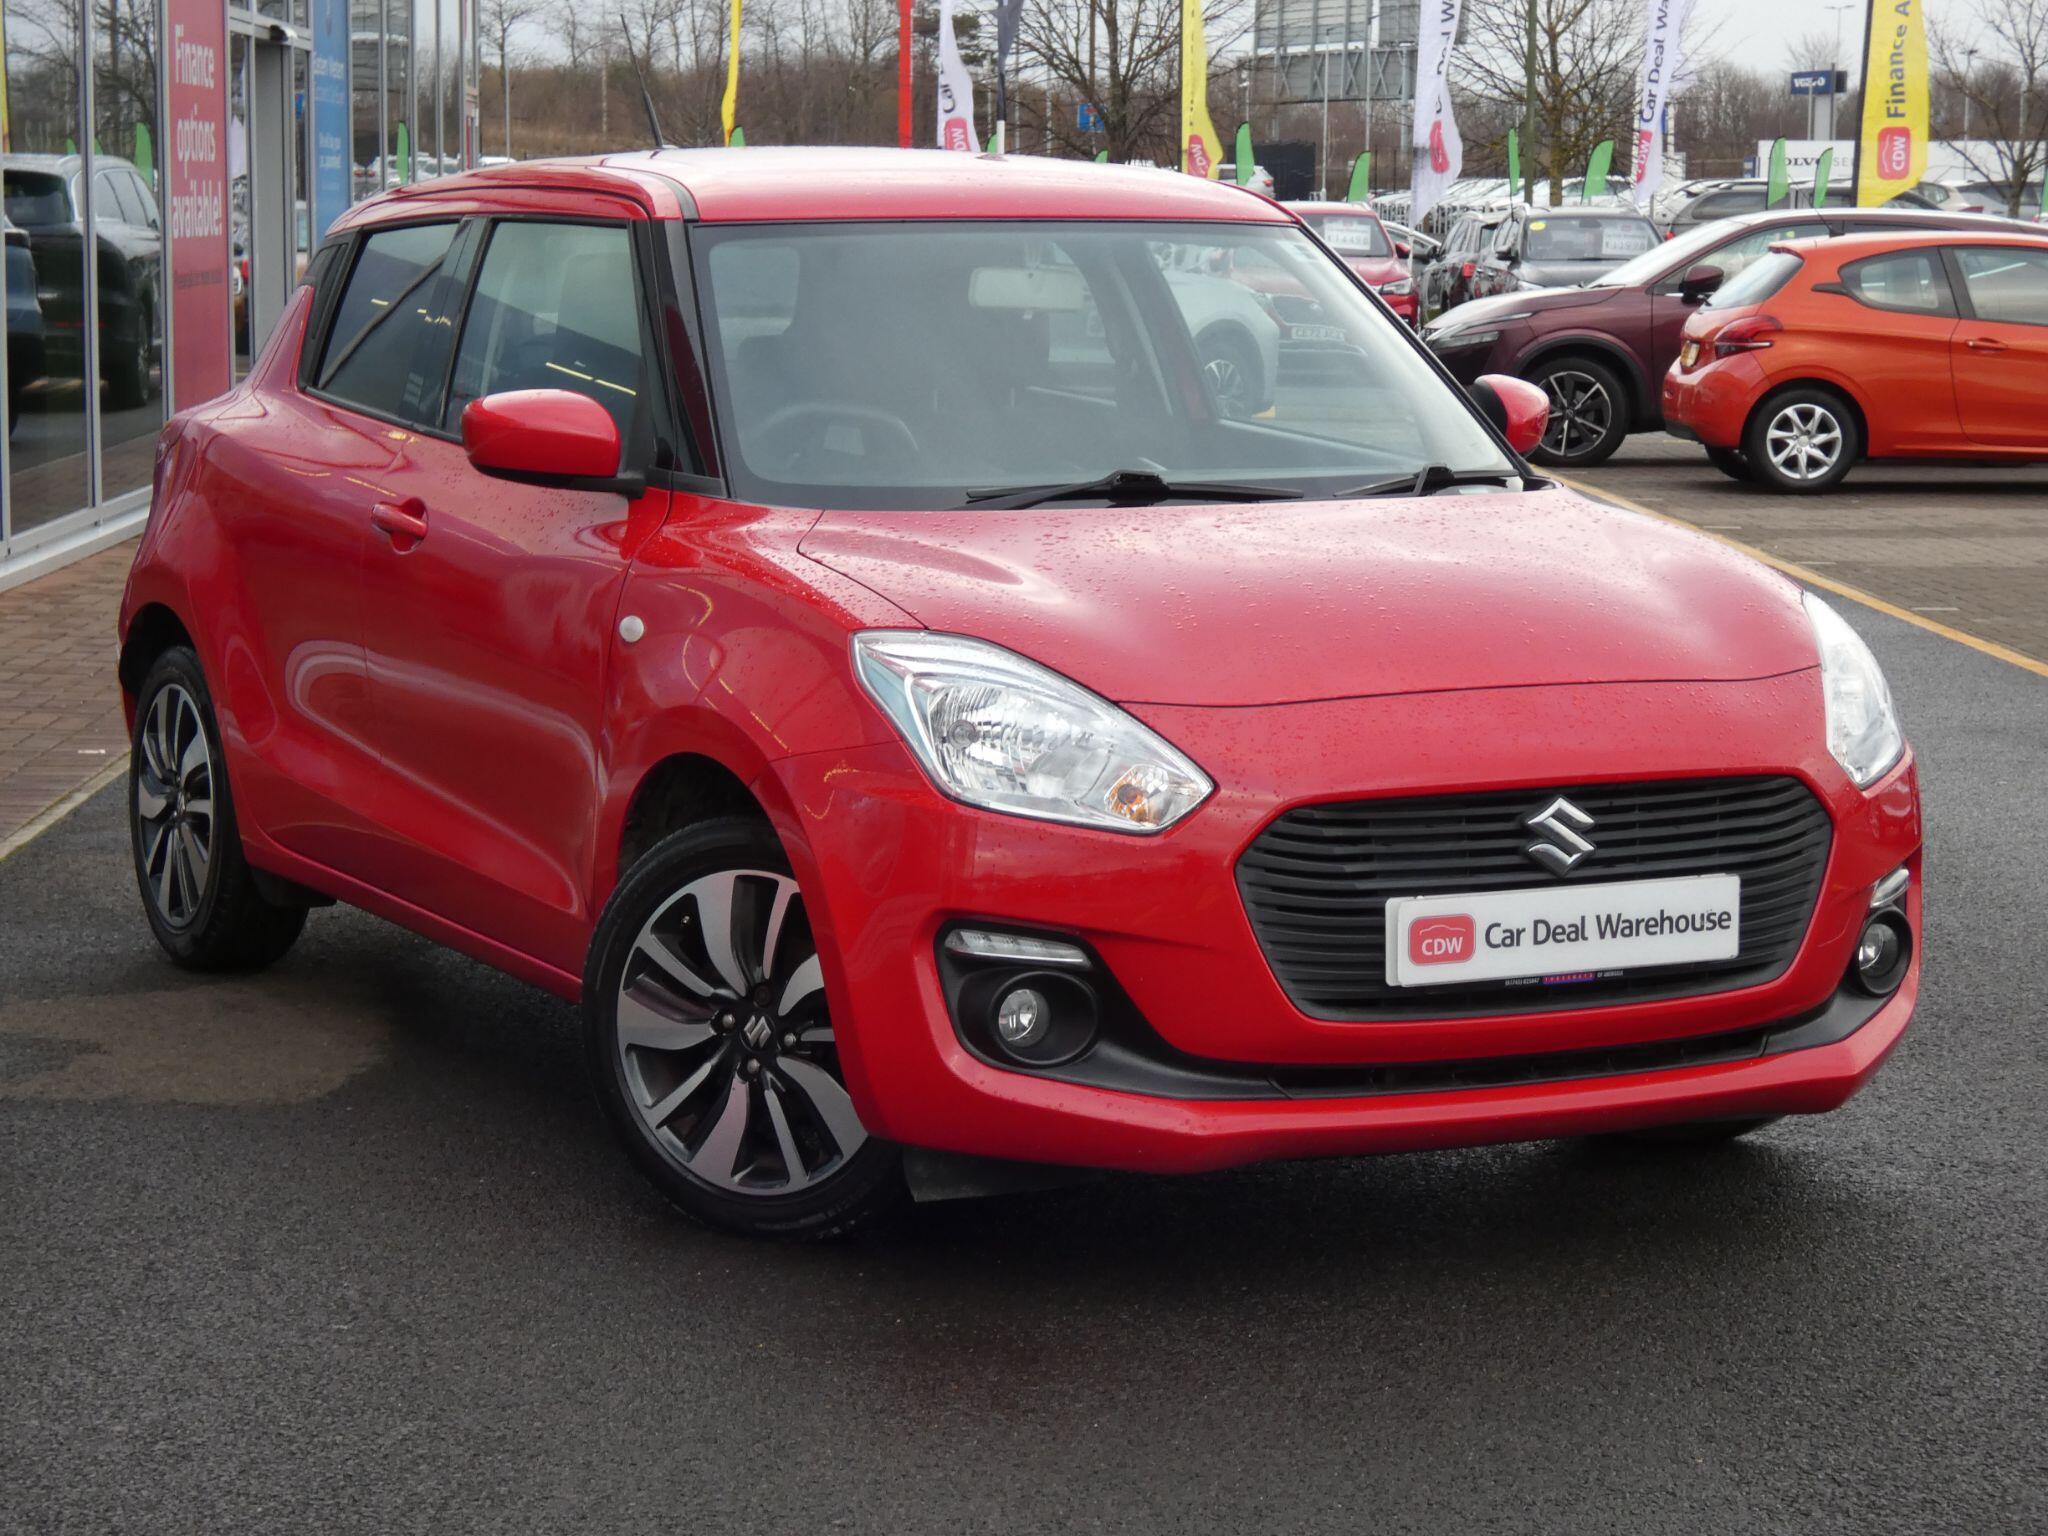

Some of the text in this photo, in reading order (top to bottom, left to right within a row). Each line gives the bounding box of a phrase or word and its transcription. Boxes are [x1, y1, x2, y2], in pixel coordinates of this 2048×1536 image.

[174, 24, 215, 89] Finance
[1648, 38, 1665, 84] Deal
[1886, 24, 1907, 118] Finance
[1640, 89, 1657, 123] Car
[176, 104, 216, 178] options
[951, 127, 967, 151] DW
[1892, 136, 1907, 171] CDW
[172, 179, 223, 239] available!
[1421, 936, 1463, 956] CDW
[1485, 909, 1732, 949] Car Deal Warehouse
